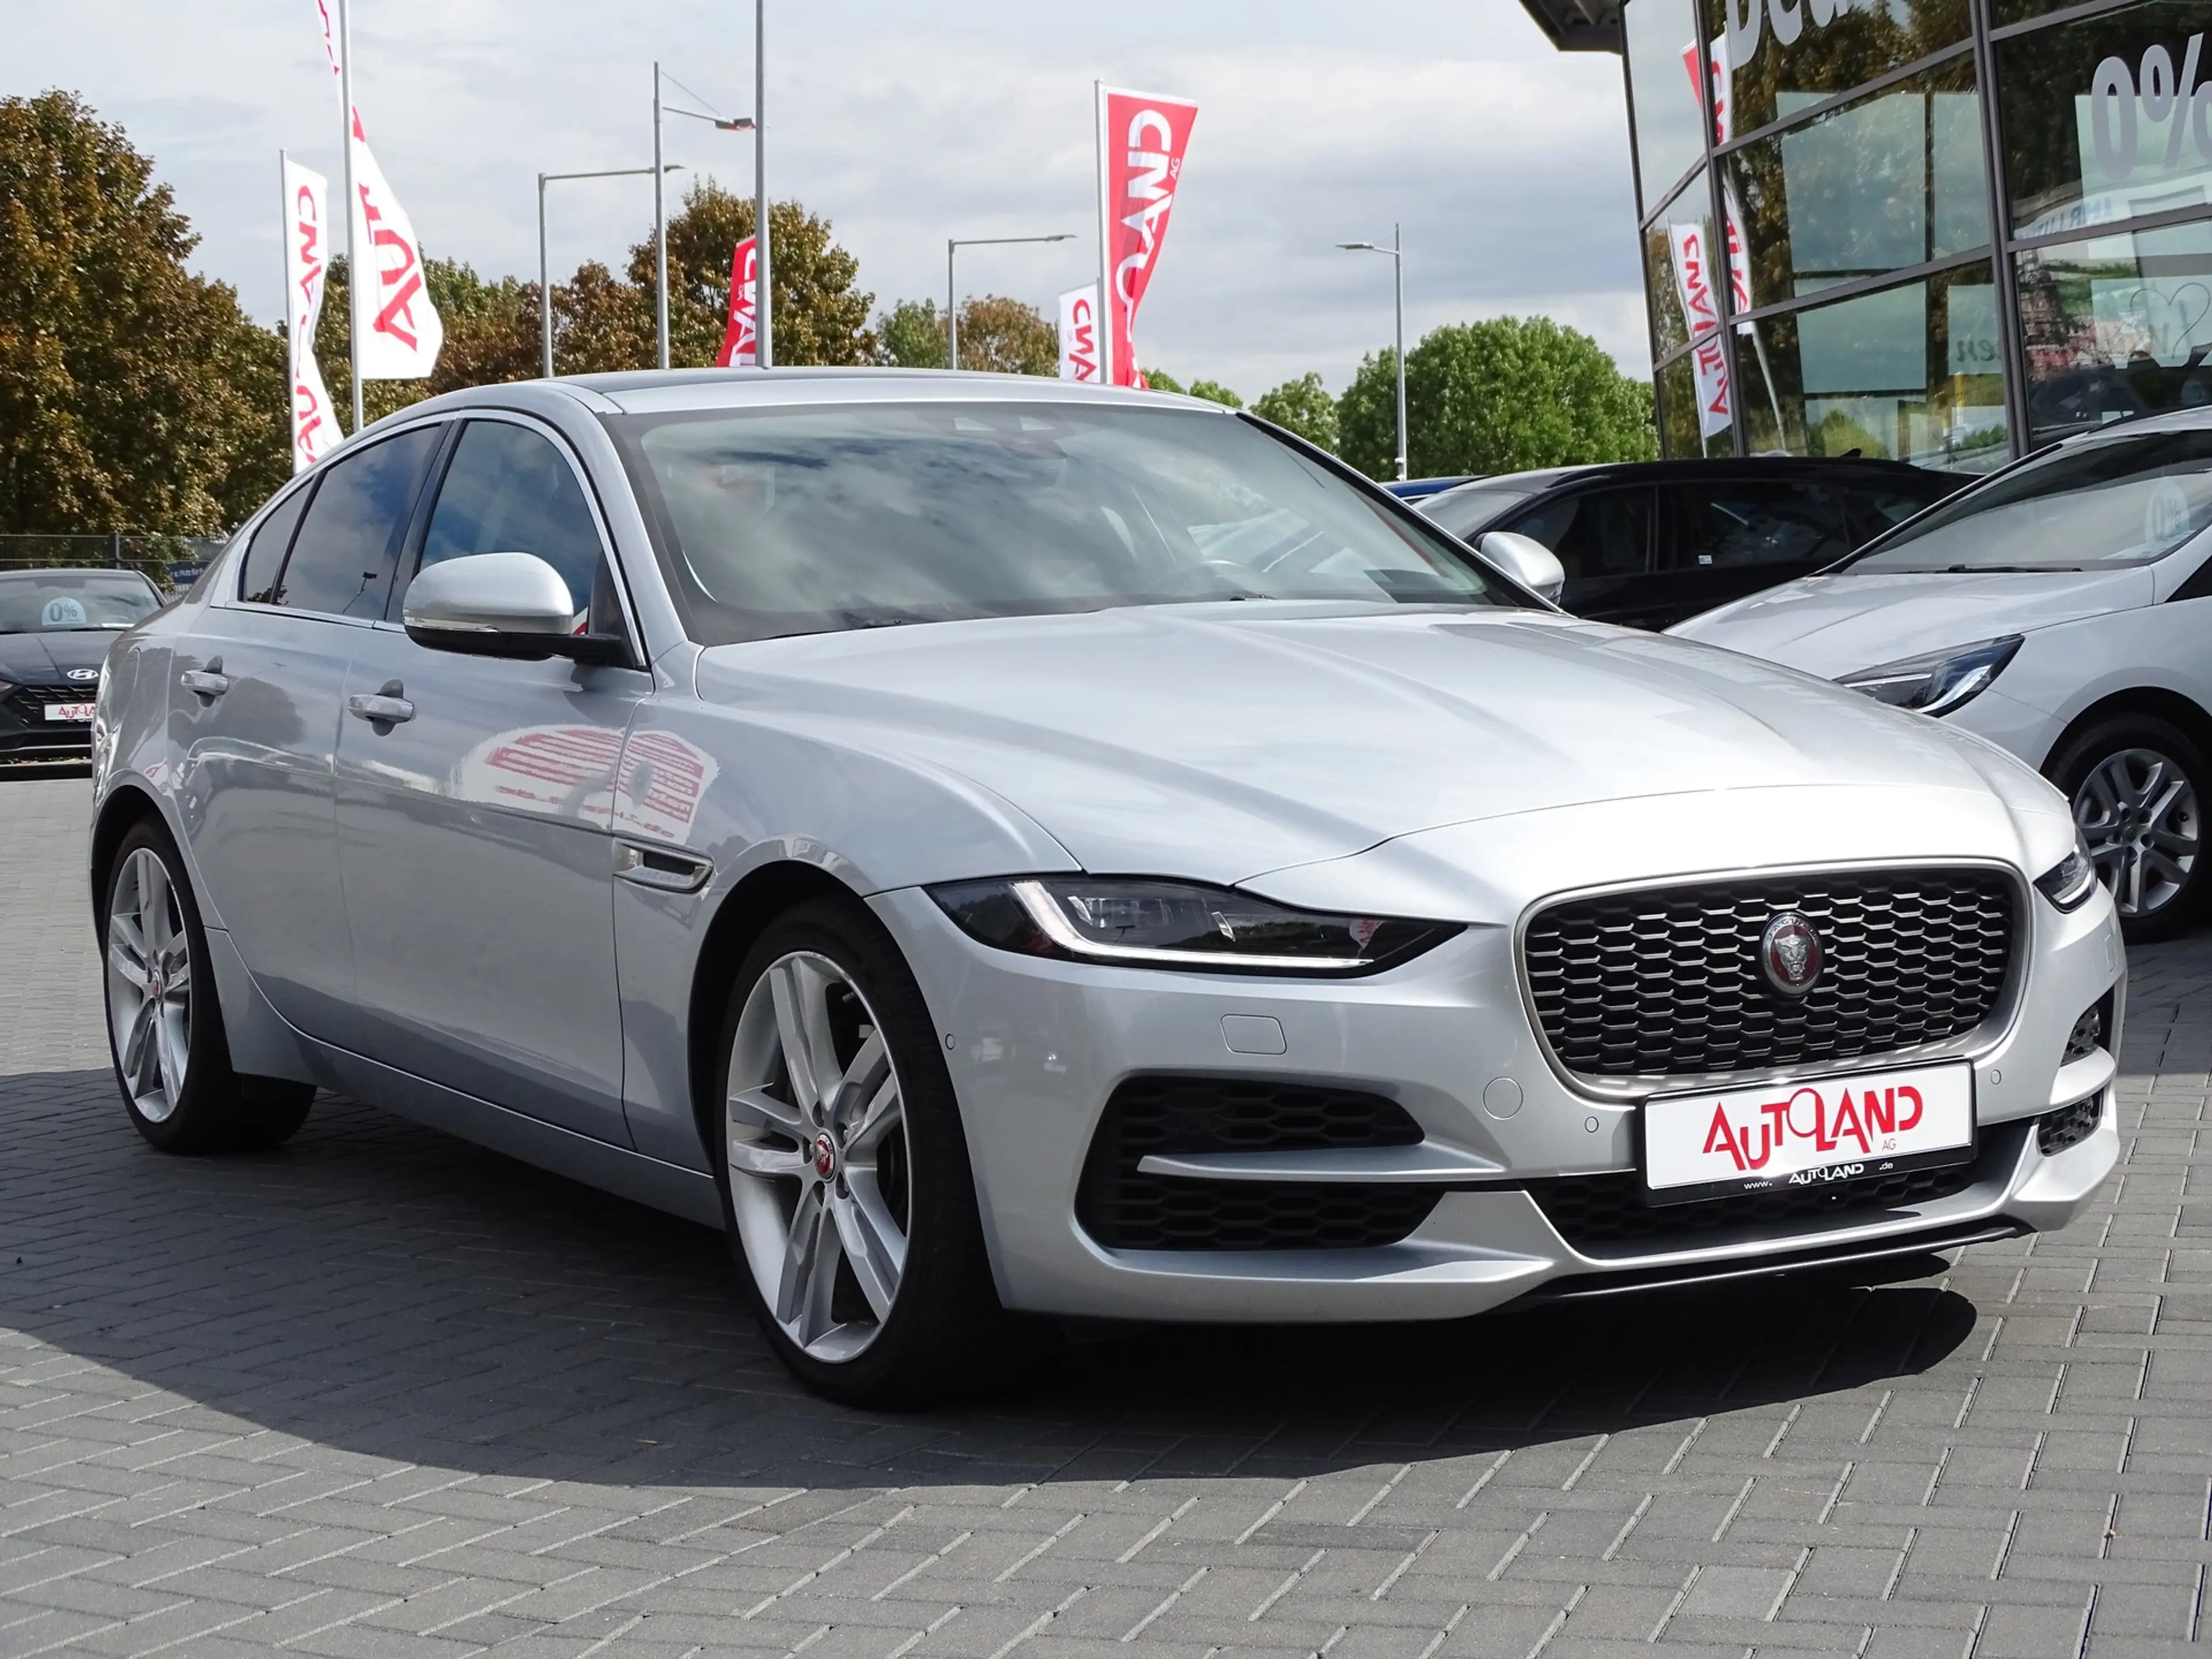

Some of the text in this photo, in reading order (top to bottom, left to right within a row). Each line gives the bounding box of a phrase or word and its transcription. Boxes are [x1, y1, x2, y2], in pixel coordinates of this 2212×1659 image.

[2091, 32, 2212, 181] 0%
[50, 603, 77, 622] 0%
[58, 704, 96, 718] AUTOLA
[1702, 1086, 1923, 1171] AUTOLAND
[1882, 1139, 1896, 1151] AG
[1744, 1161, 1893, 1190] www. AUTOLAND .de
